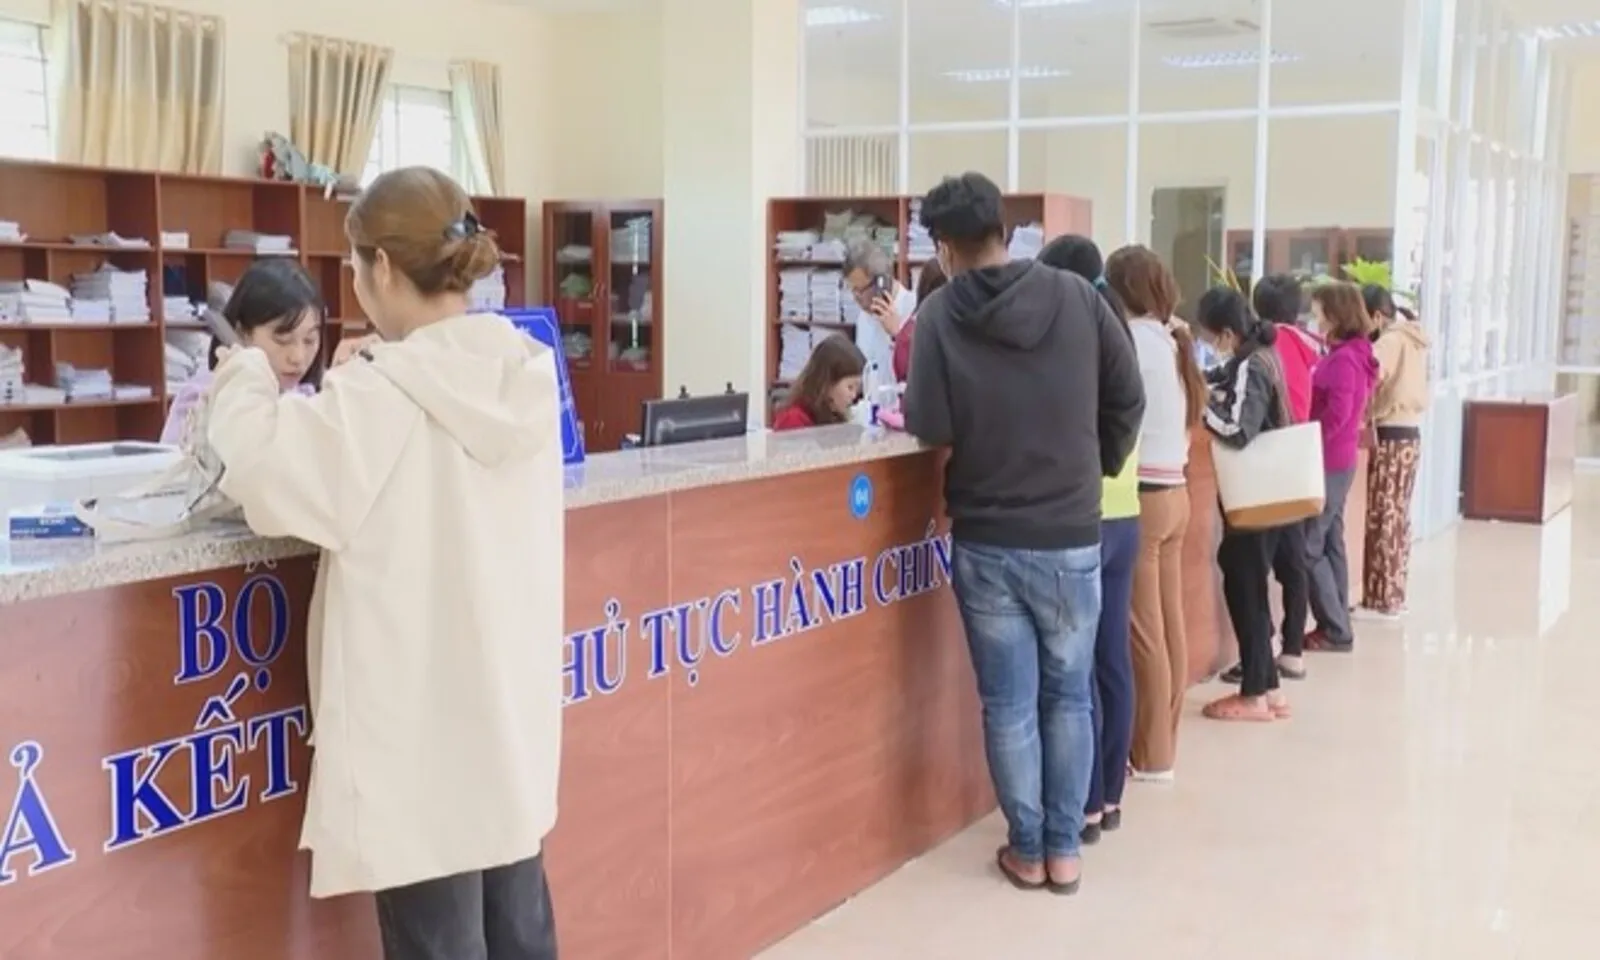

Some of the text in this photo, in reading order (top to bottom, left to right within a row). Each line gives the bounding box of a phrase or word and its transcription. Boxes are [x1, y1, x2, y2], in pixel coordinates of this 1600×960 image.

[102, 673, 307, 853] KẾT
[640, 587, 741, 687] TỤC
[751, 555, 868, 647] HÀNH
